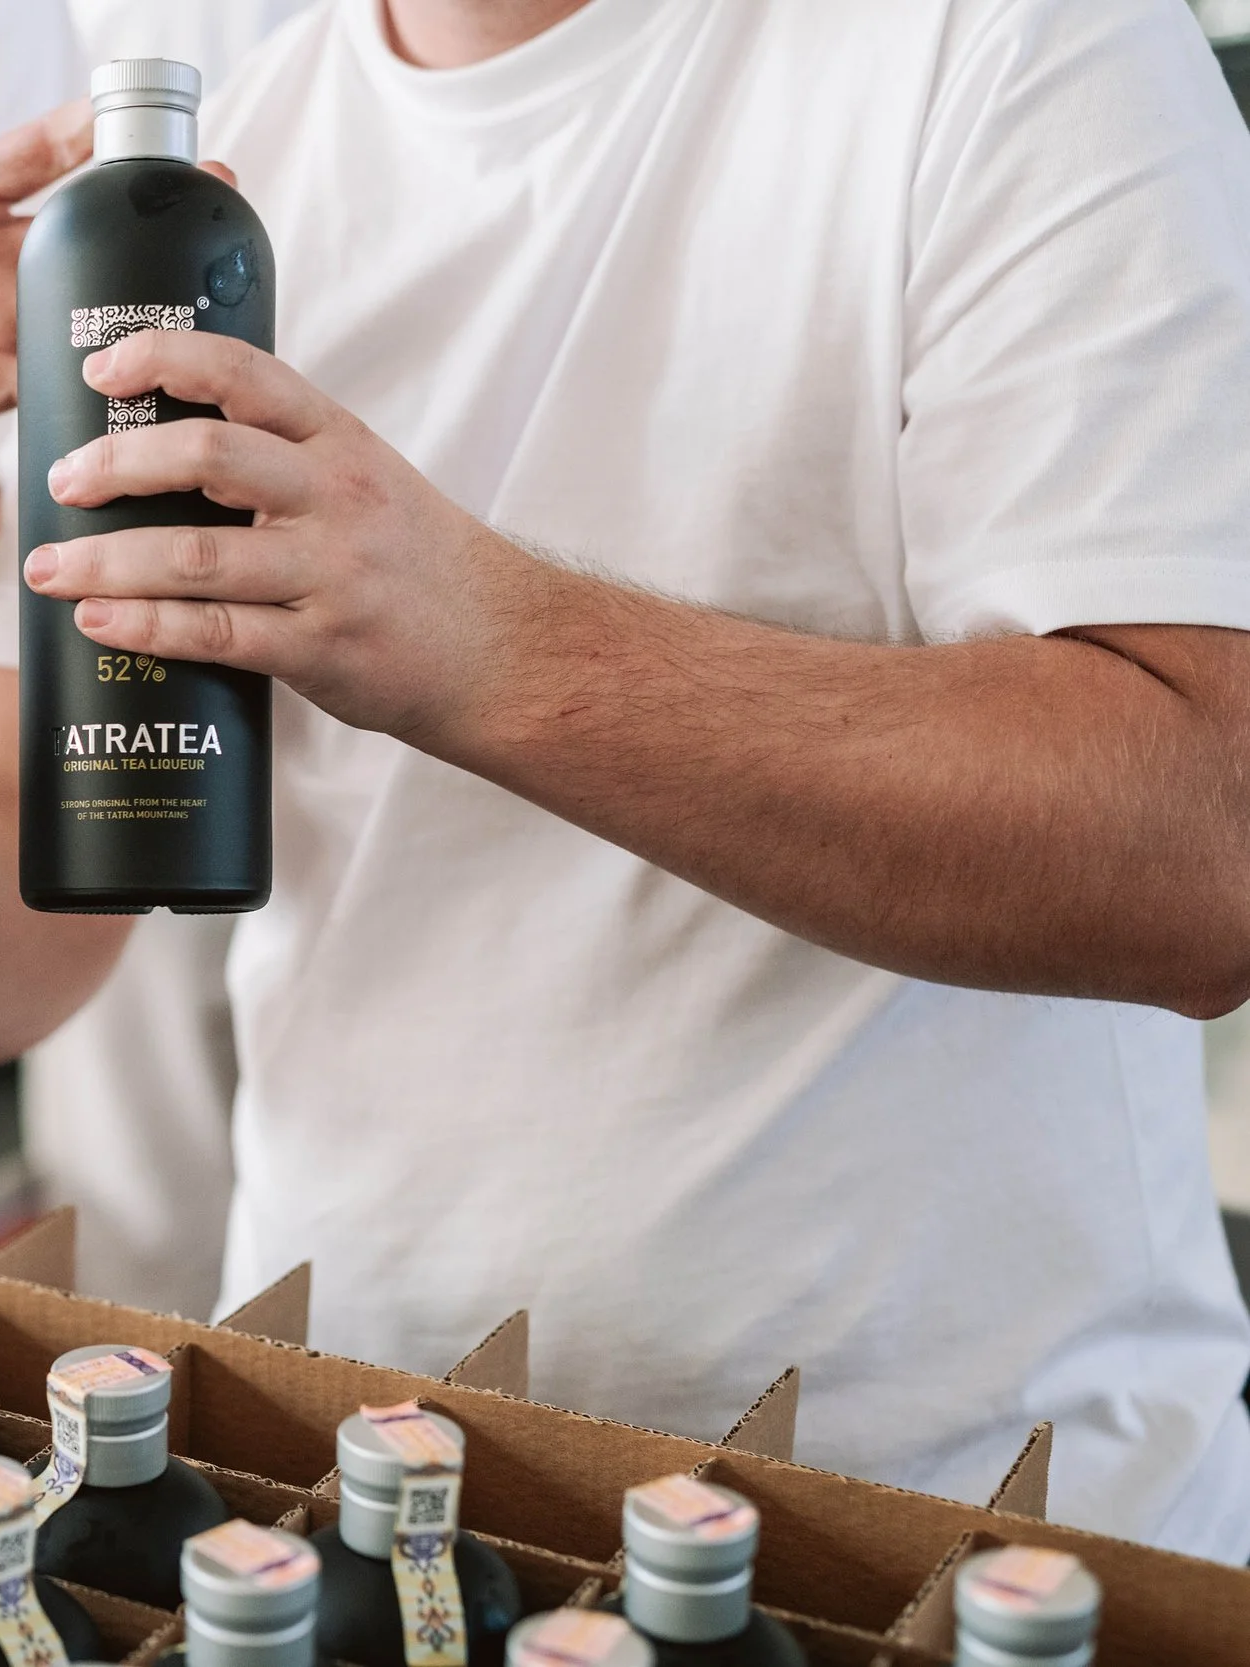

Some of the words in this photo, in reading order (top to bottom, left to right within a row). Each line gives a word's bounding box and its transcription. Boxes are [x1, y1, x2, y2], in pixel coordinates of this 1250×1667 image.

[97, 654, 167, 683] 52%
[63, 759, 118, 773] ORIGINAL
[121, 759, 147, 771] TEA
[150, 758, 205, 771] LIQUEUR
[61, 799, 90, 810] STRONG
[92, 799, 132, 808] ORIGINAL
[134, 798, 159, 807] FROM
[161, 798, 179, 807] THE
[180, 798, 207, 807] HEART
[77, 811, 88, 821] OF
[89, 811, 105, 820] THE
[107, 810, 135, 820] TATRA
[136, 810, 189, 820] MOUNTAINS
